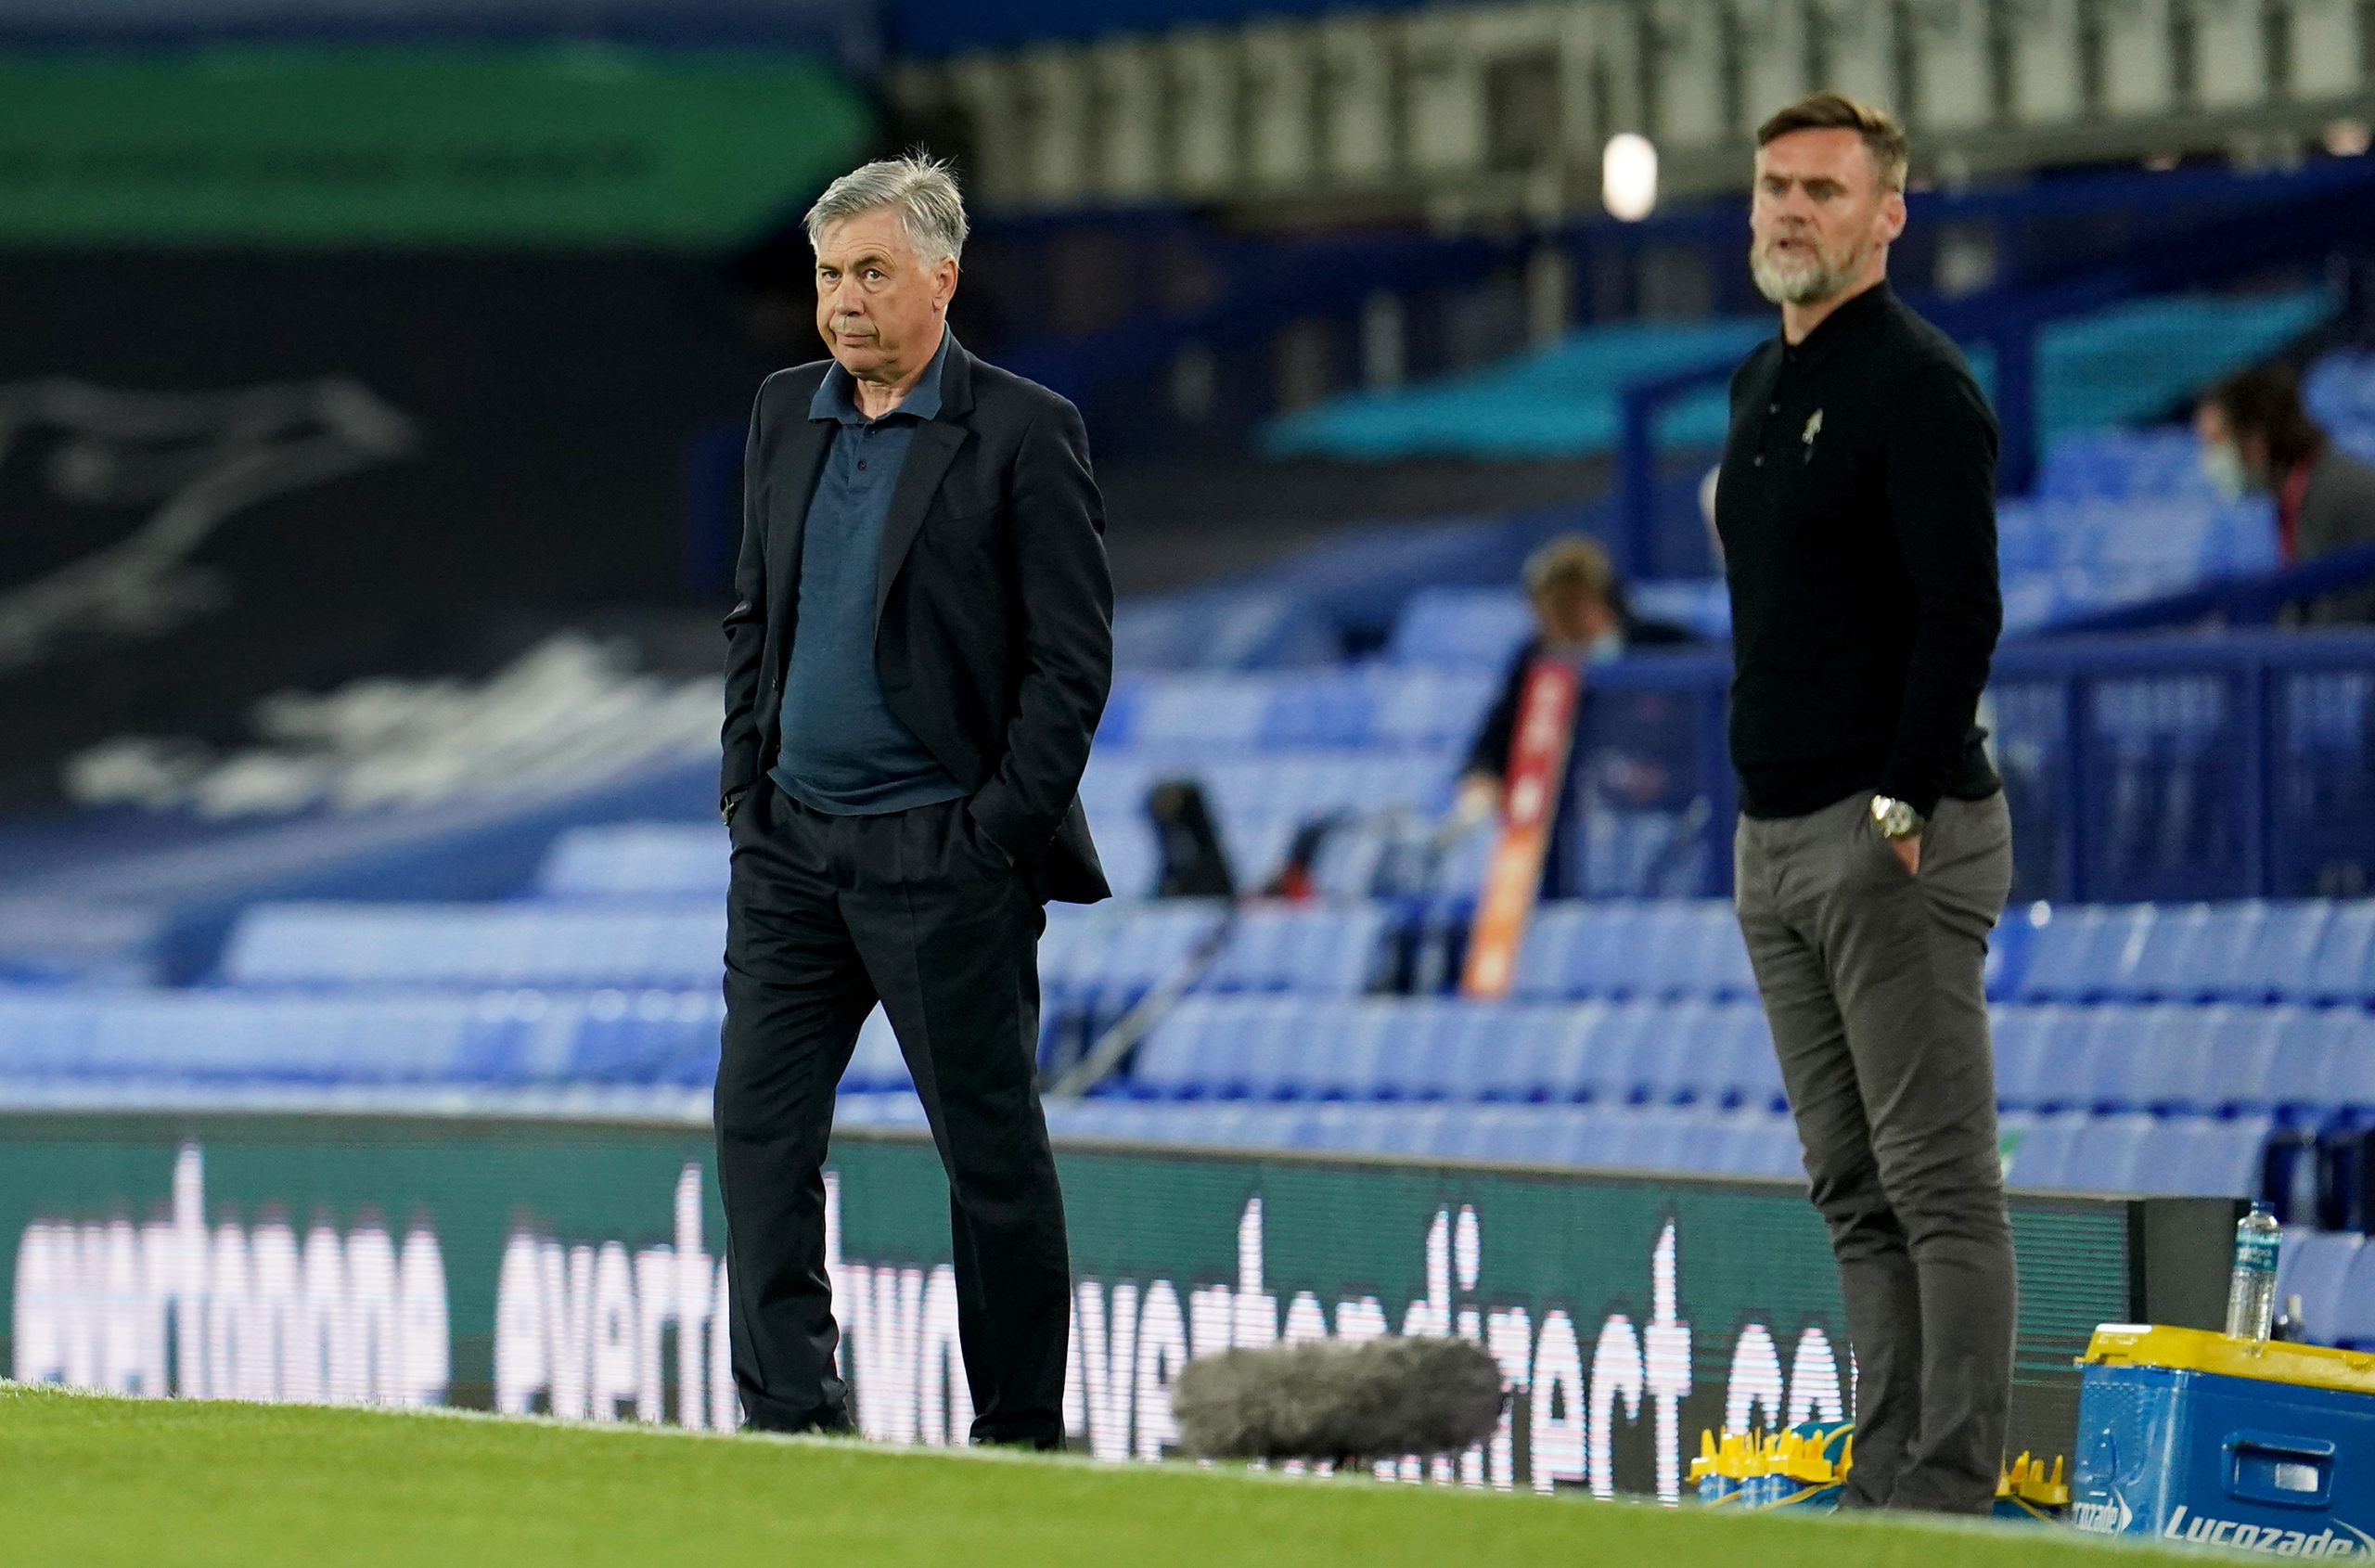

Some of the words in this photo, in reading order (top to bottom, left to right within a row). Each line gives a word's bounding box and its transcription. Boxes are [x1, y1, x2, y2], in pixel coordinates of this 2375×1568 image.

[493, 1163, 972, 1446] everttwo
[1064, 1197, 1857, 1508] vetdirectco
[2072, 1497, 2119, 1535] cozade
[2163, 1504, 2355, 1560] Lucozade
